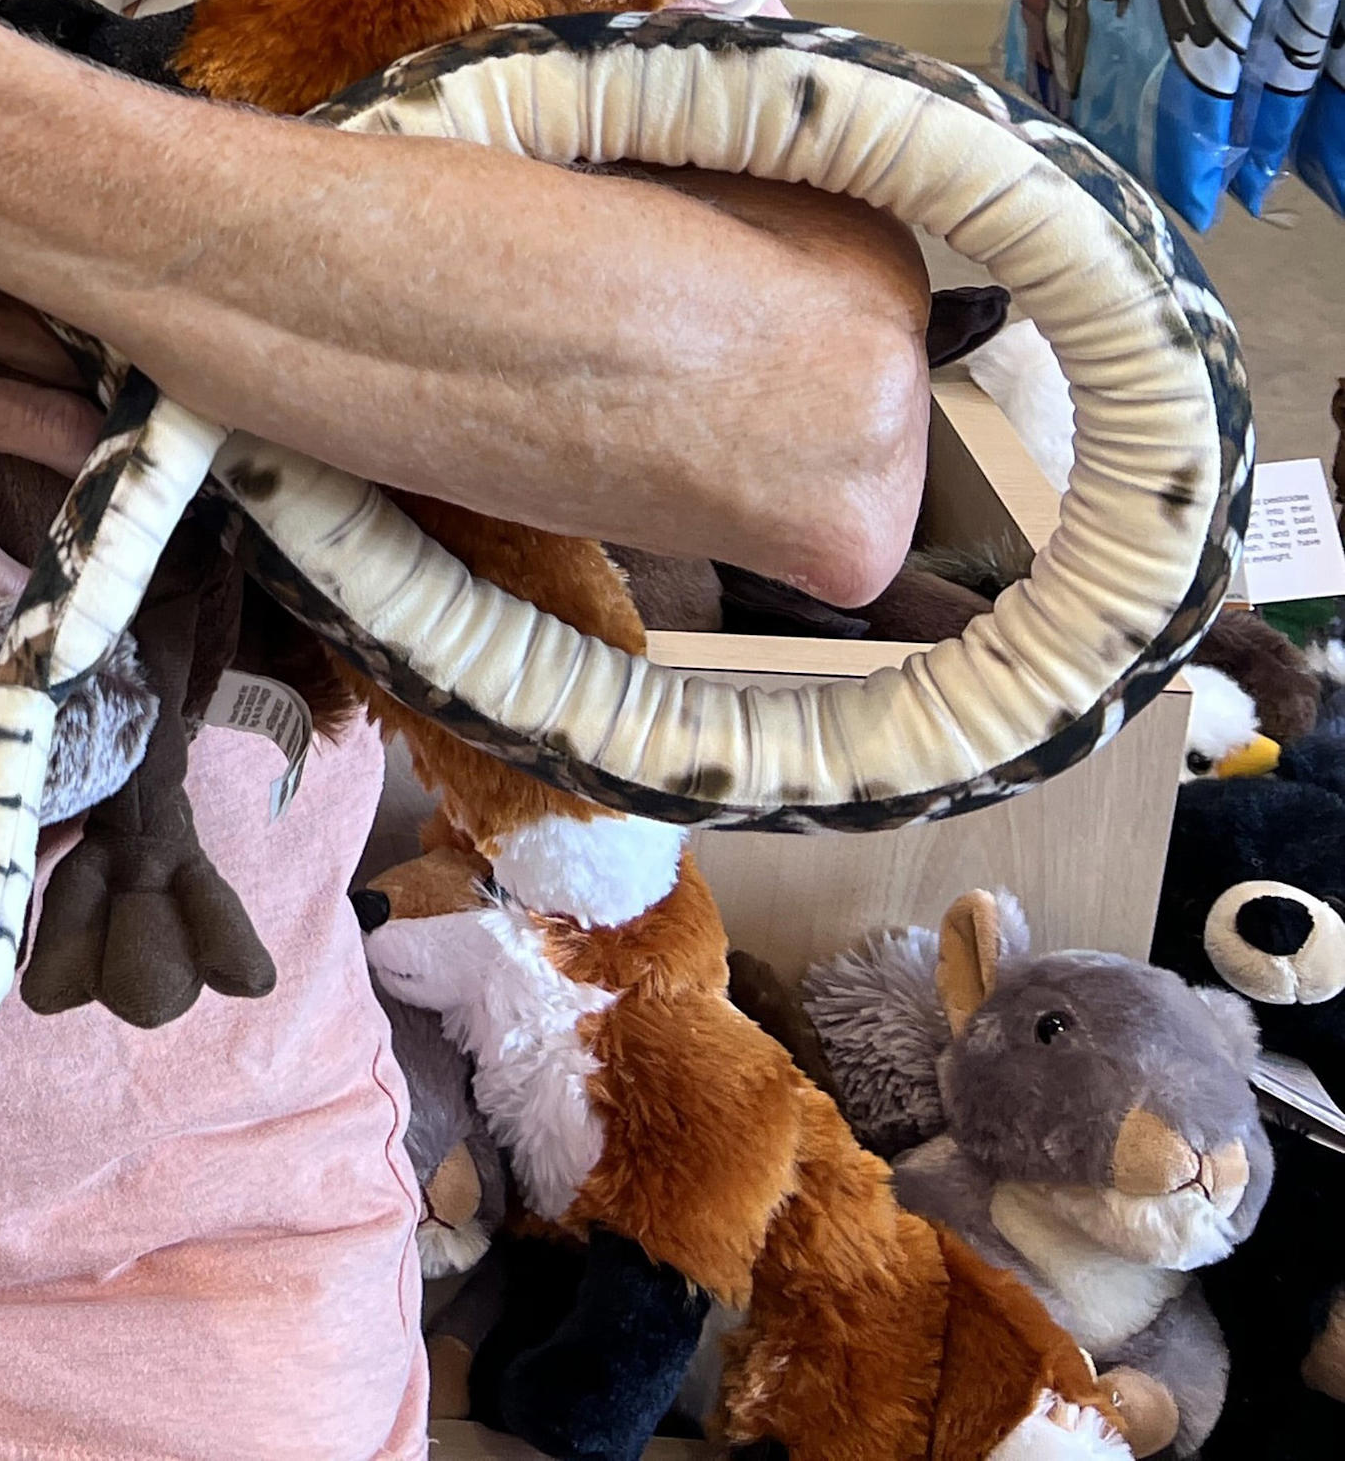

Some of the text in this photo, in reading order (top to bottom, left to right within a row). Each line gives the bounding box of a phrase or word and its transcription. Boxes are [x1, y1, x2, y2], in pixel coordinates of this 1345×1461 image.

[1263, 494, 1309, 505] pesticides
[1291, 505, 1311, 513] their
[1267, 518, 1286, 526] The
[1293, 516, 1315, 525] bald
[1272, 530, 1290, 538] and
[1297, 527, 1318, 535] eats
[1268, 541, 1291, 550] They
[1297, 539, 1321, 547] have
